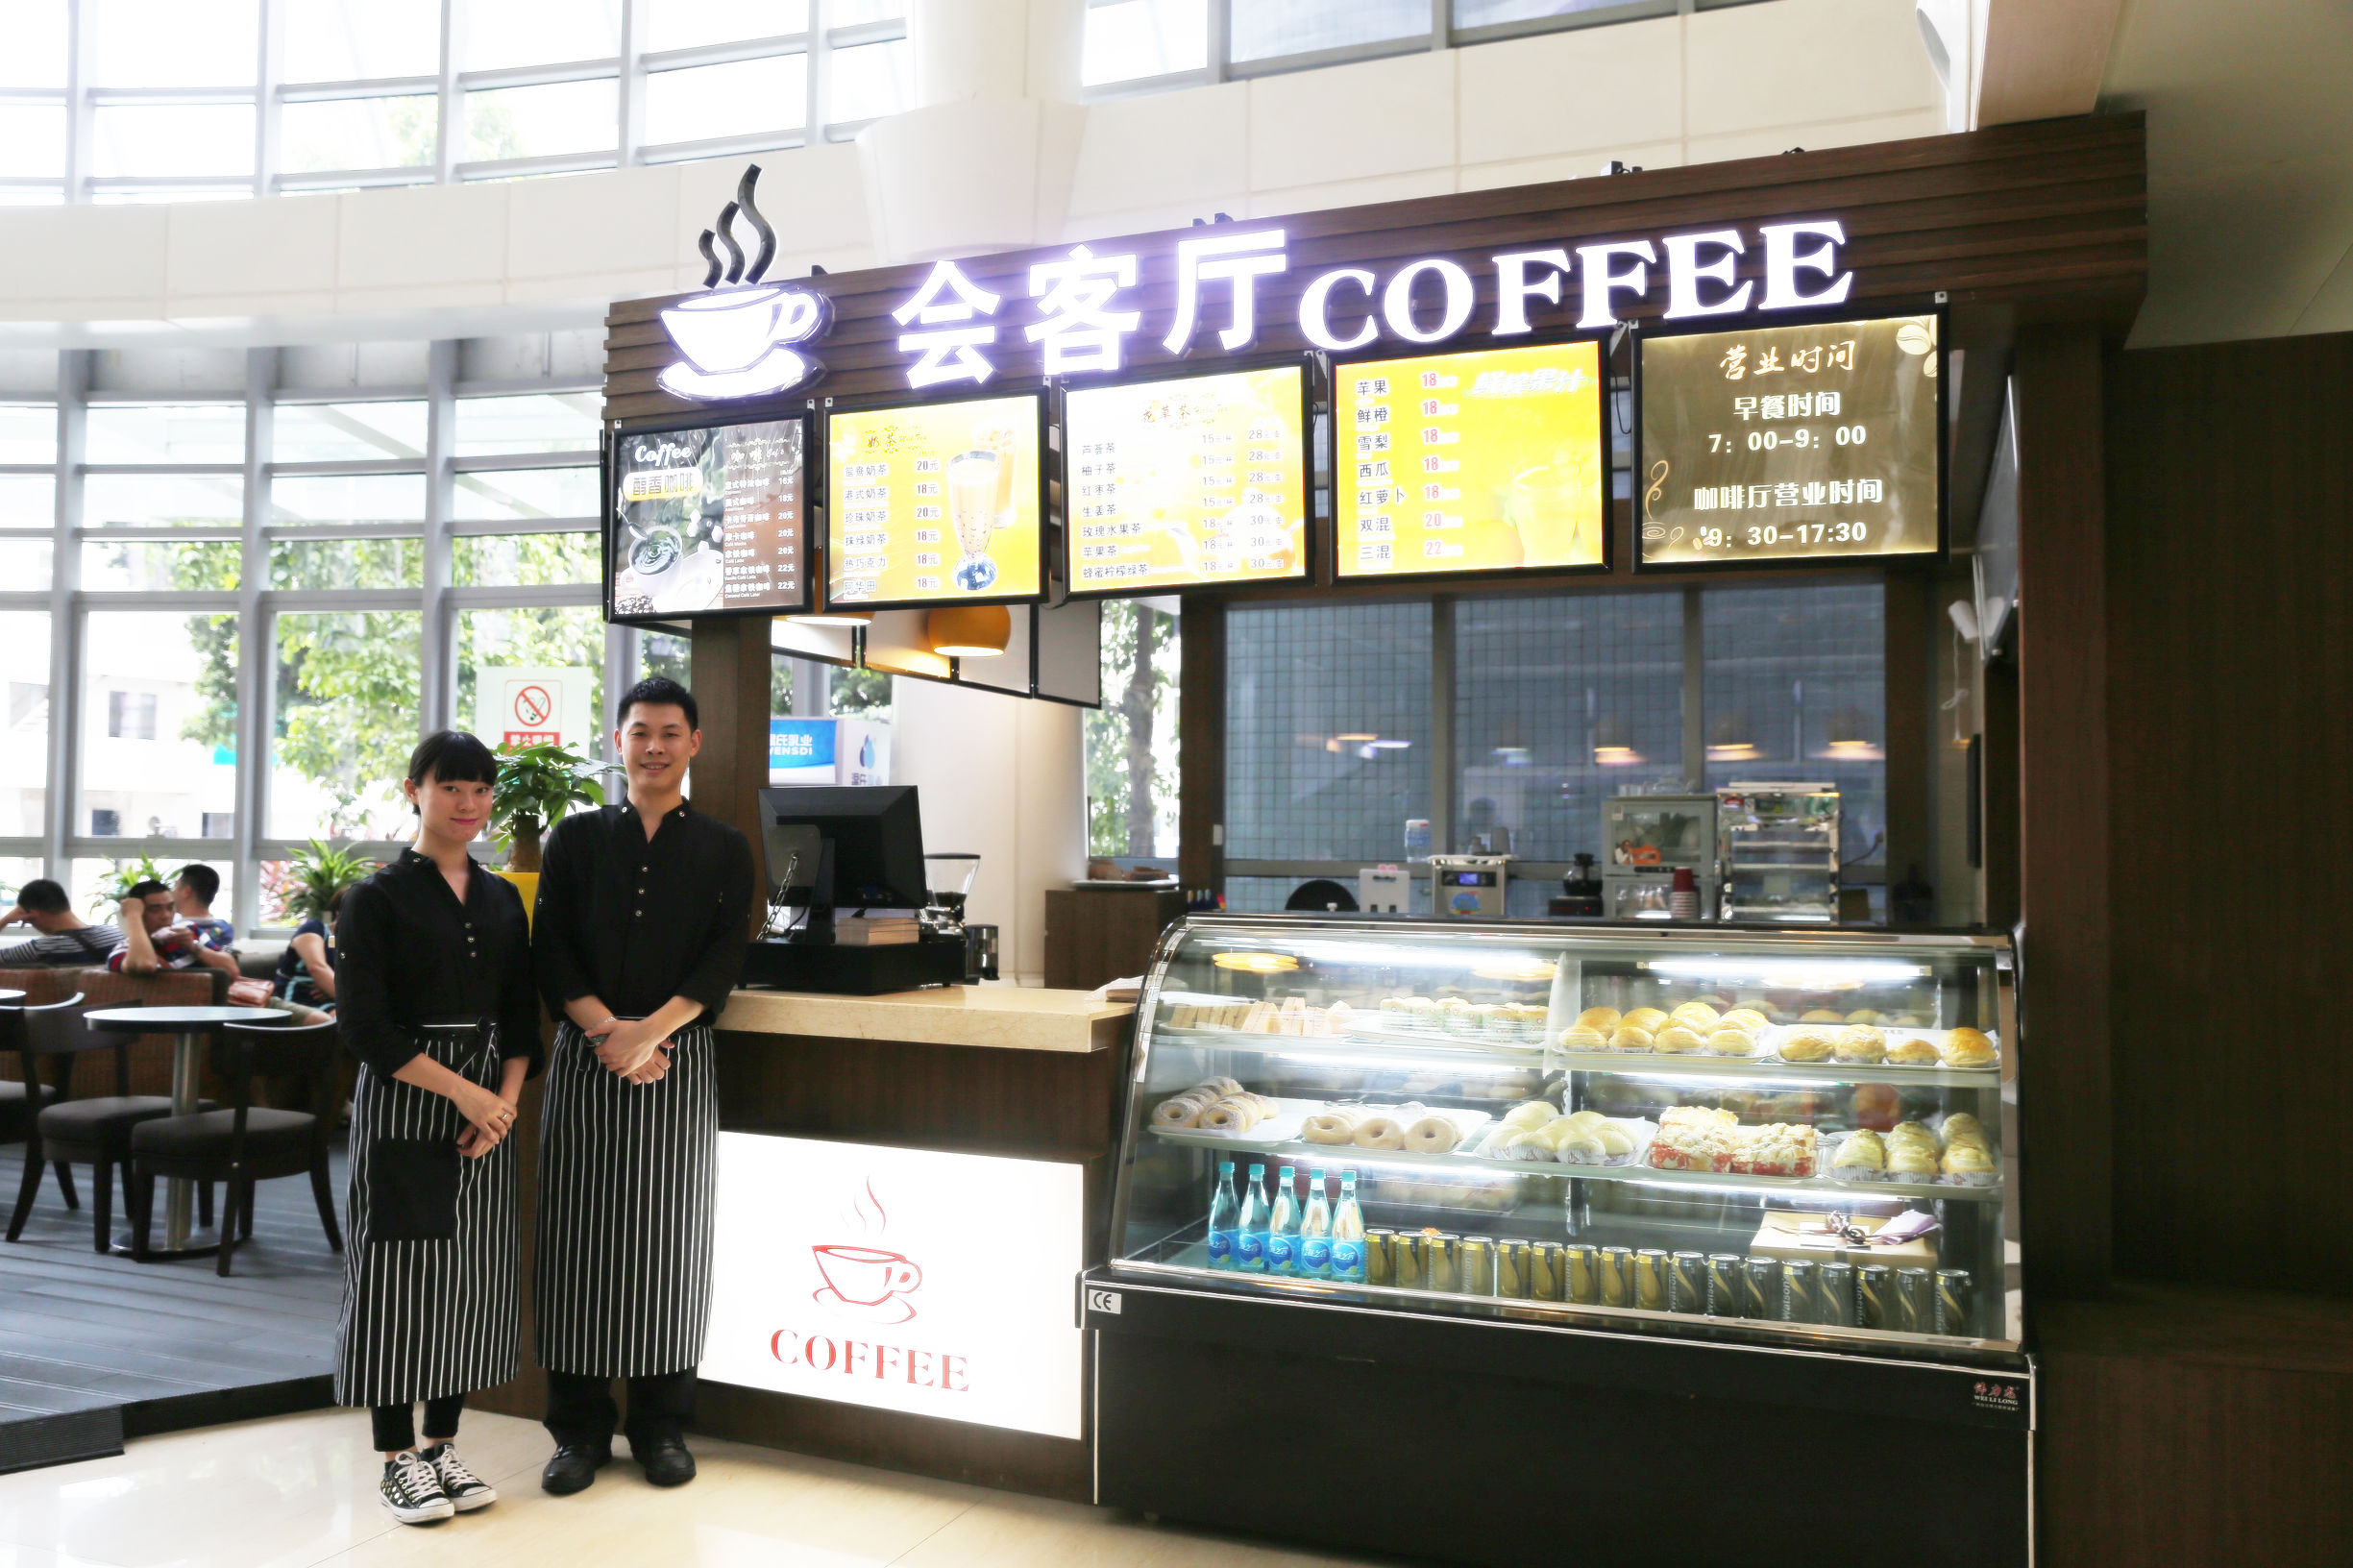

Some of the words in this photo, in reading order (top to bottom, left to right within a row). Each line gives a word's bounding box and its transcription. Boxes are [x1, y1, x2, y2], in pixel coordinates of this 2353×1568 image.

[892, 228, 1287, 390] 会客厅
[1298, 220, 1853, 351] COFFEE
[1720, 340, 1856, 380] 营业时间
[1357, 380, 1387, 396] 苹果
[1733, 391, 1841, 421] 早餐时间
[1358, 407, 1388, 423] 鲜橙
[1359, 435, 1389, 451] 雪梨
[634, 442, 692, 466] Coffee
[917, 460, 939, 471] 20元
[1082, 463, 1115, 477] 柚子茶
[1359, 462, 1389, 478] 西瓜
[633, 473, 693, 496] 醇香咖啡
[845, 487, 887, 500] 港式奶茶
[917, 484, 939, 494] 18元
[1082, 483, 1115, 496] 红枣茶
[1360, 487, 1405, 504] 红萝卜
[1694, 478, 1883, 511] 咖啡厅营业时间
[845, 511, 887, 523] 珍珠奶茶
[917, 507, 940, 518] 20元
[1082, 503, 1116, 517] 生姜茶
[1082, 523, 1141, 538] 玫瑰水果茶
[1360, 517, 1390, 532] 双混
[778, 528, 794, 537] 20元
[917, 530, 939, 542] 18元
[778, 546, 794, 554] 20元
[1083, 545, 1116, 557] 苹果茶
[1360, 546, 1391, 559] 三混
[844, 557, 886, 569] 热巧克力
[917, 554, 939, 565] 18元
[1083, 563, 1149, 578] 蜂蜜柠檬绿茶
[778, 581, 795, 590] 22元
[844, 580, 876, 592] 阿华田
[917, 578, 940, 589] 18元
[1093, 1291, 1113, 1311] CE
[771, 1328, 969, 1392] COFFEE
